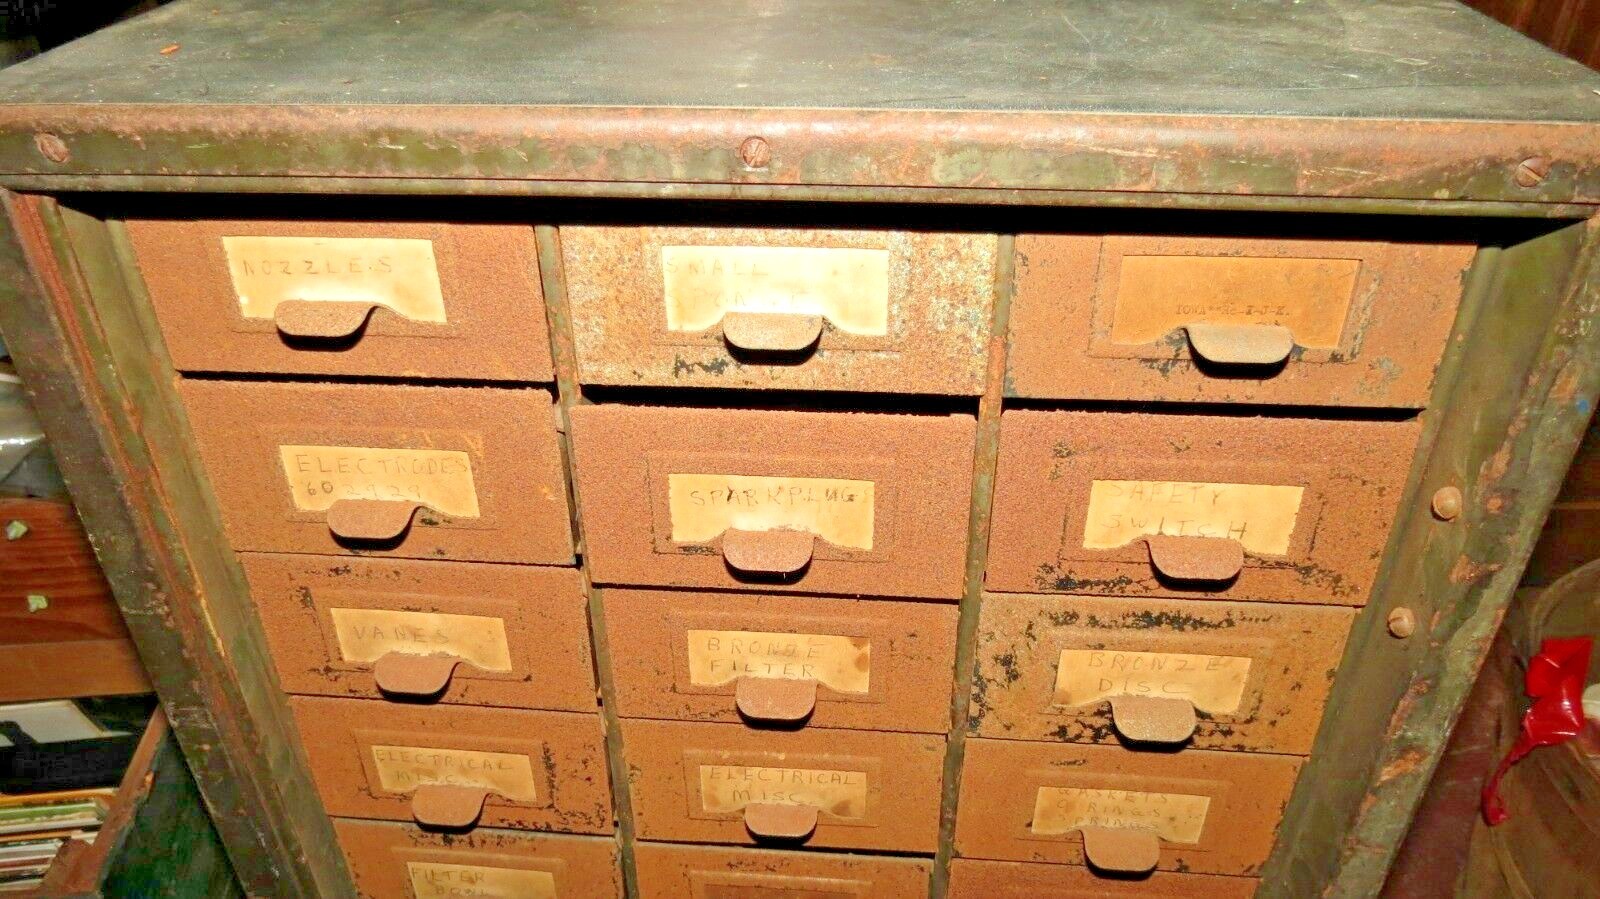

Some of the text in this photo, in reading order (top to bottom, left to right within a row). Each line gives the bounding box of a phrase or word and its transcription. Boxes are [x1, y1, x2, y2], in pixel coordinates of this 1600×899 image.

[242, 255, 393, 275] NOZZLES
[1106, 483, 1226, 507] SAFETY
[1101, 514, 1248, 539] SWITCH
[352, 625, 450, 645] VANES
[710, 658, 816, 678] FILTER
[1088, 652, 1228, 673] BRONZE
[1098, 677, 1193, 694] DISC
[375, 749, 512, 771] ELECTRICAL
[710, 766, 857, 785] ELECTRICAL
[732, 789, 803, 805] MISC
[411, 867, 486, 882] FILTER
